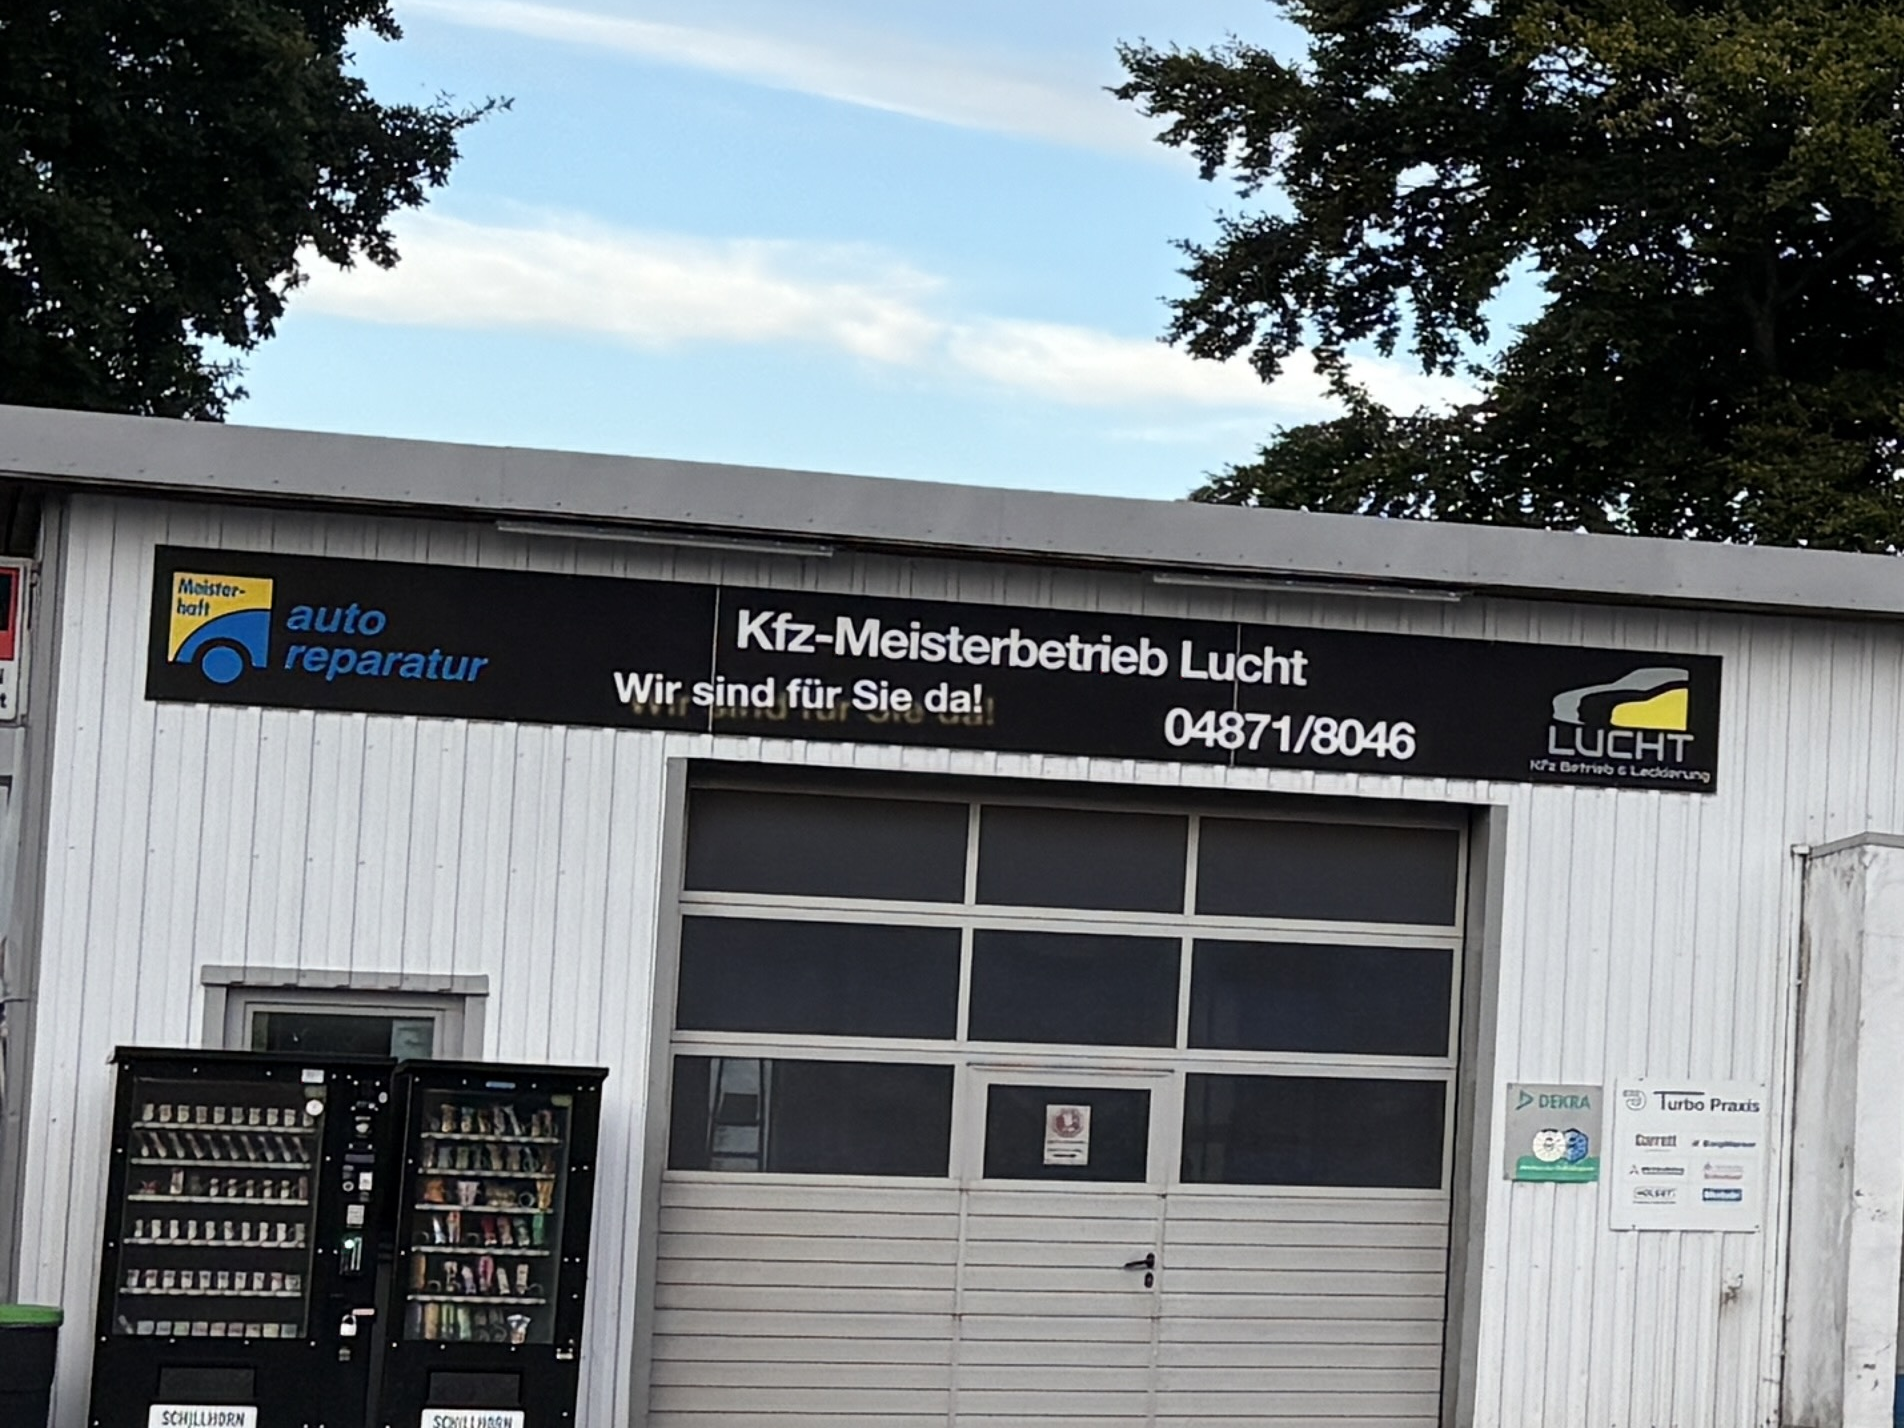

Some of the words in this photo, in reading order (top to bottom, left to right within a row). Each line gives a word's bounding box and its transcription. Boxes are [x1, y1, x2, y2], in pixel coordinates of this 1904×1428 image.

[178, 577, 246, 597] Meister-
[177, 597, 209, 616] haft
[285, 602, 387, 636] auto
[284, 644, 489, 683] reparatur
[737, 609, 1168, 677] Kfz-Meisterbetrieb
[1180, 640, 1309, 687] Lucht
[613, 671, 682, 705] Wir
[692, 676, 775, 709] sind
[786, 678, 842, 710] für
[852, 679, 913, 713] Sie
[924, 681, 983, 715] da!
[1164, 707, 1416, 760] 04871/8046
[1548, 725, 1694, 762] LUCHT
[1560, 761, 1614, 776] Betrieb
[1538, 1093, 1590, 1110] DEKRA
[1653, 1091, 1705, 1112] Turbo
[1711, 1097, 1760, 1113] Praxis
